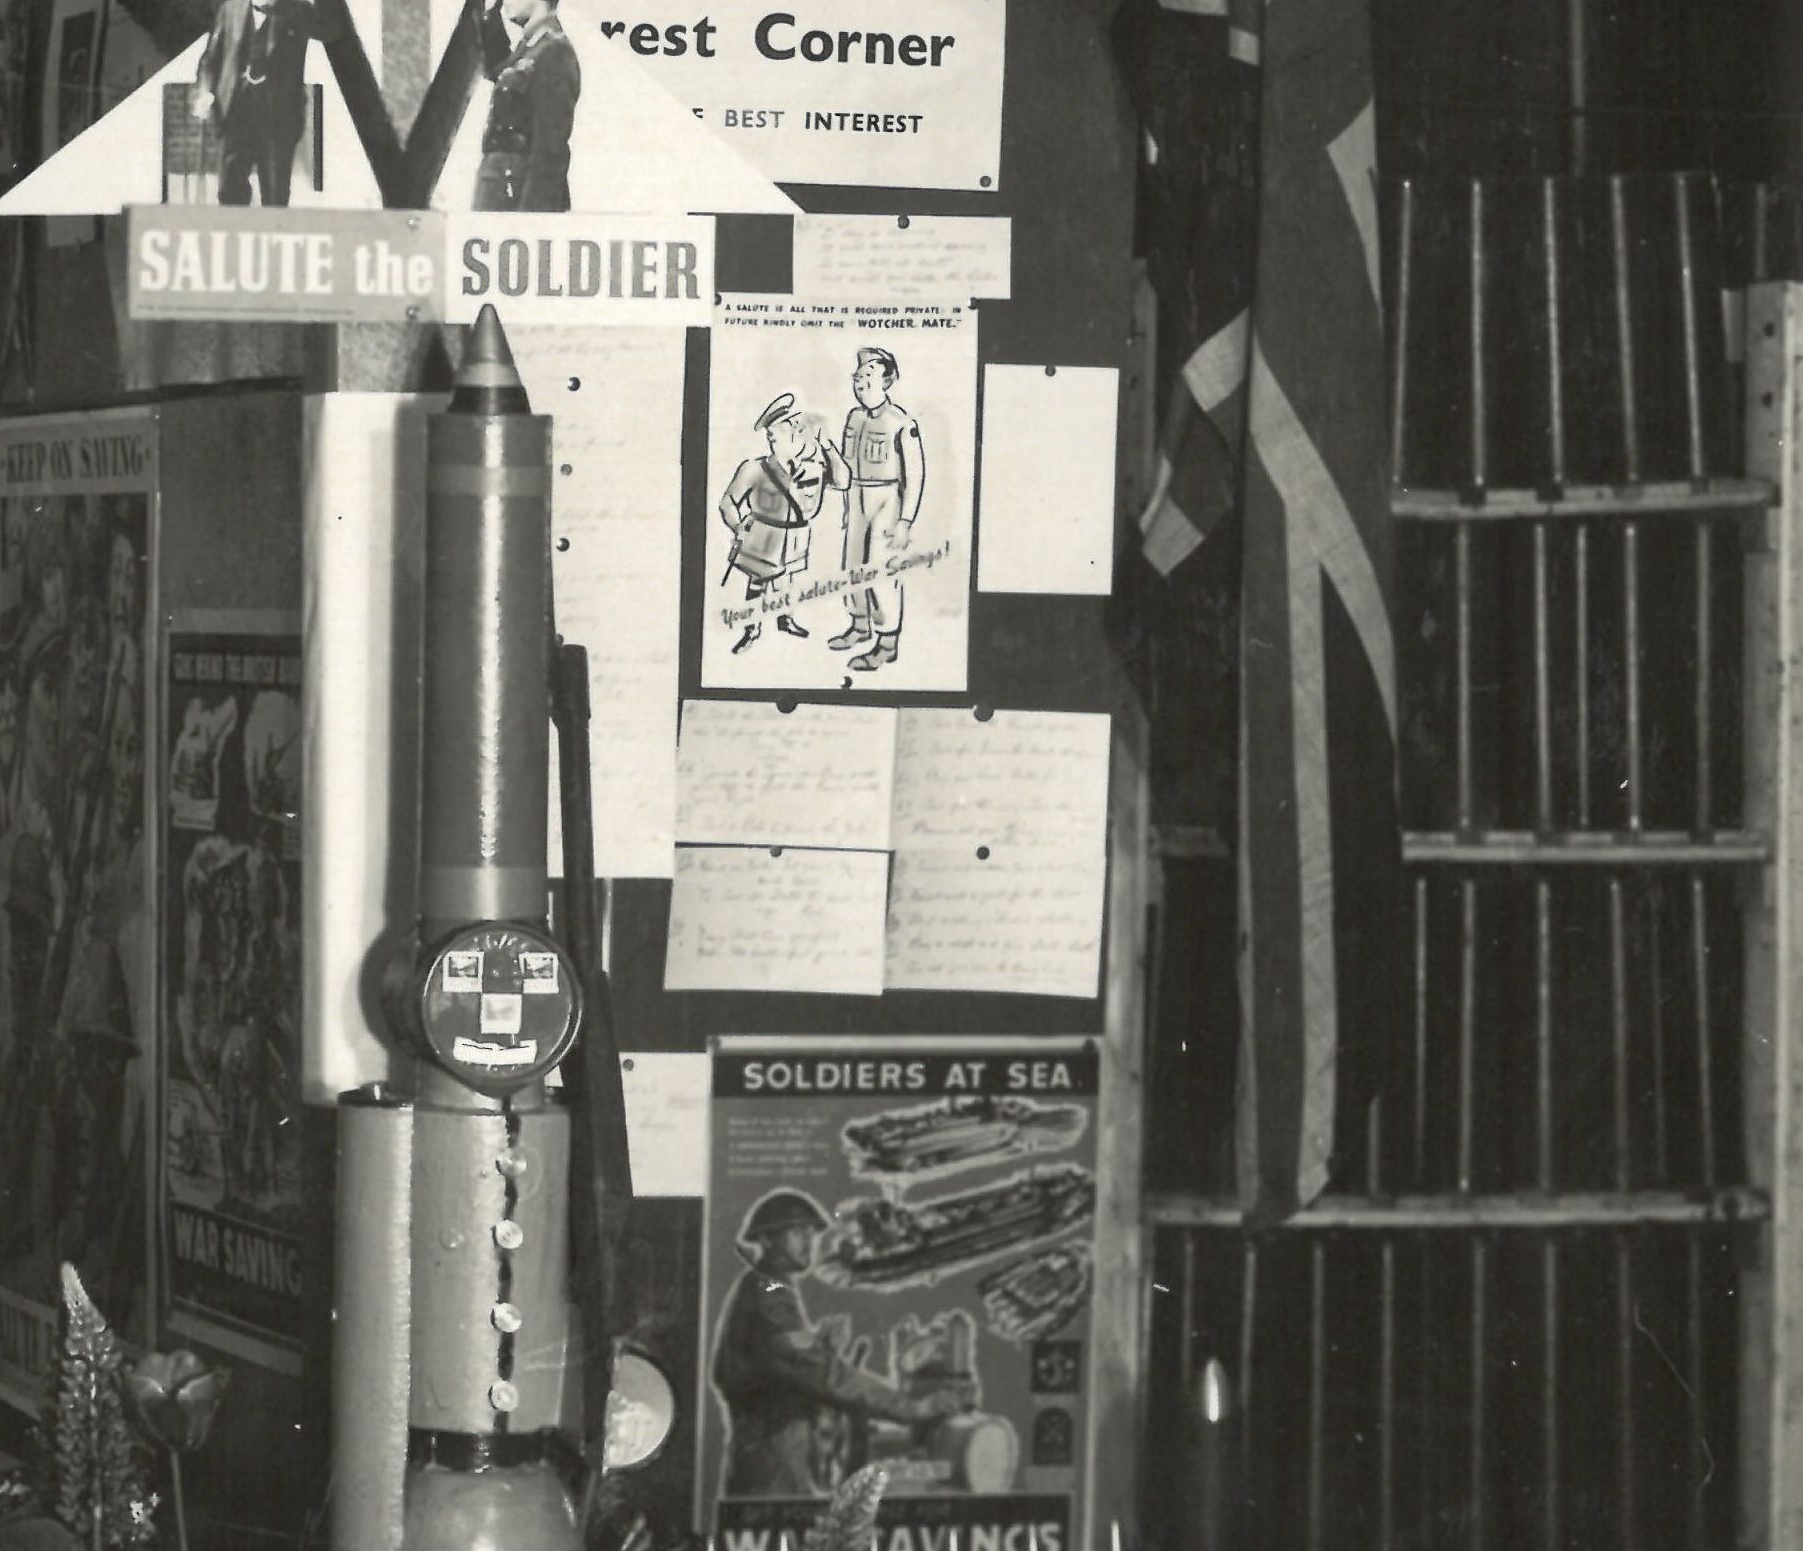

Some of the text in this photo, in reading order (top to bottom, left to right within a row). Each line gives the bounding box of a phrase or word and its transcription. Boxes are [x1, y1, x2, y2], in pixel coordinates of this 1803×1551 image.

[753, 12, 956, 67] Corner
[725, 108, 786, 130] BEST
[804, 110, 924, 135] INTEREST
[139, 229, 701, 300] SALUTE the SOLDIER
[724, 303, 732, 312] A
[736, 304, 769, 313] SALUTE
[789, 305, 806, 314] ALL
[811, 305, 836, 314] THAT
[840, 306, 849, 314] IS
[855, 306, 899, 315] REQUIRED
[724, 317, 758, 326] FUTURE
[828, 320, 846, 328] THE
[50, 439, 73, 480] ON
[743, 1061, 1071, 1092] SOLDIERS AT SEA
